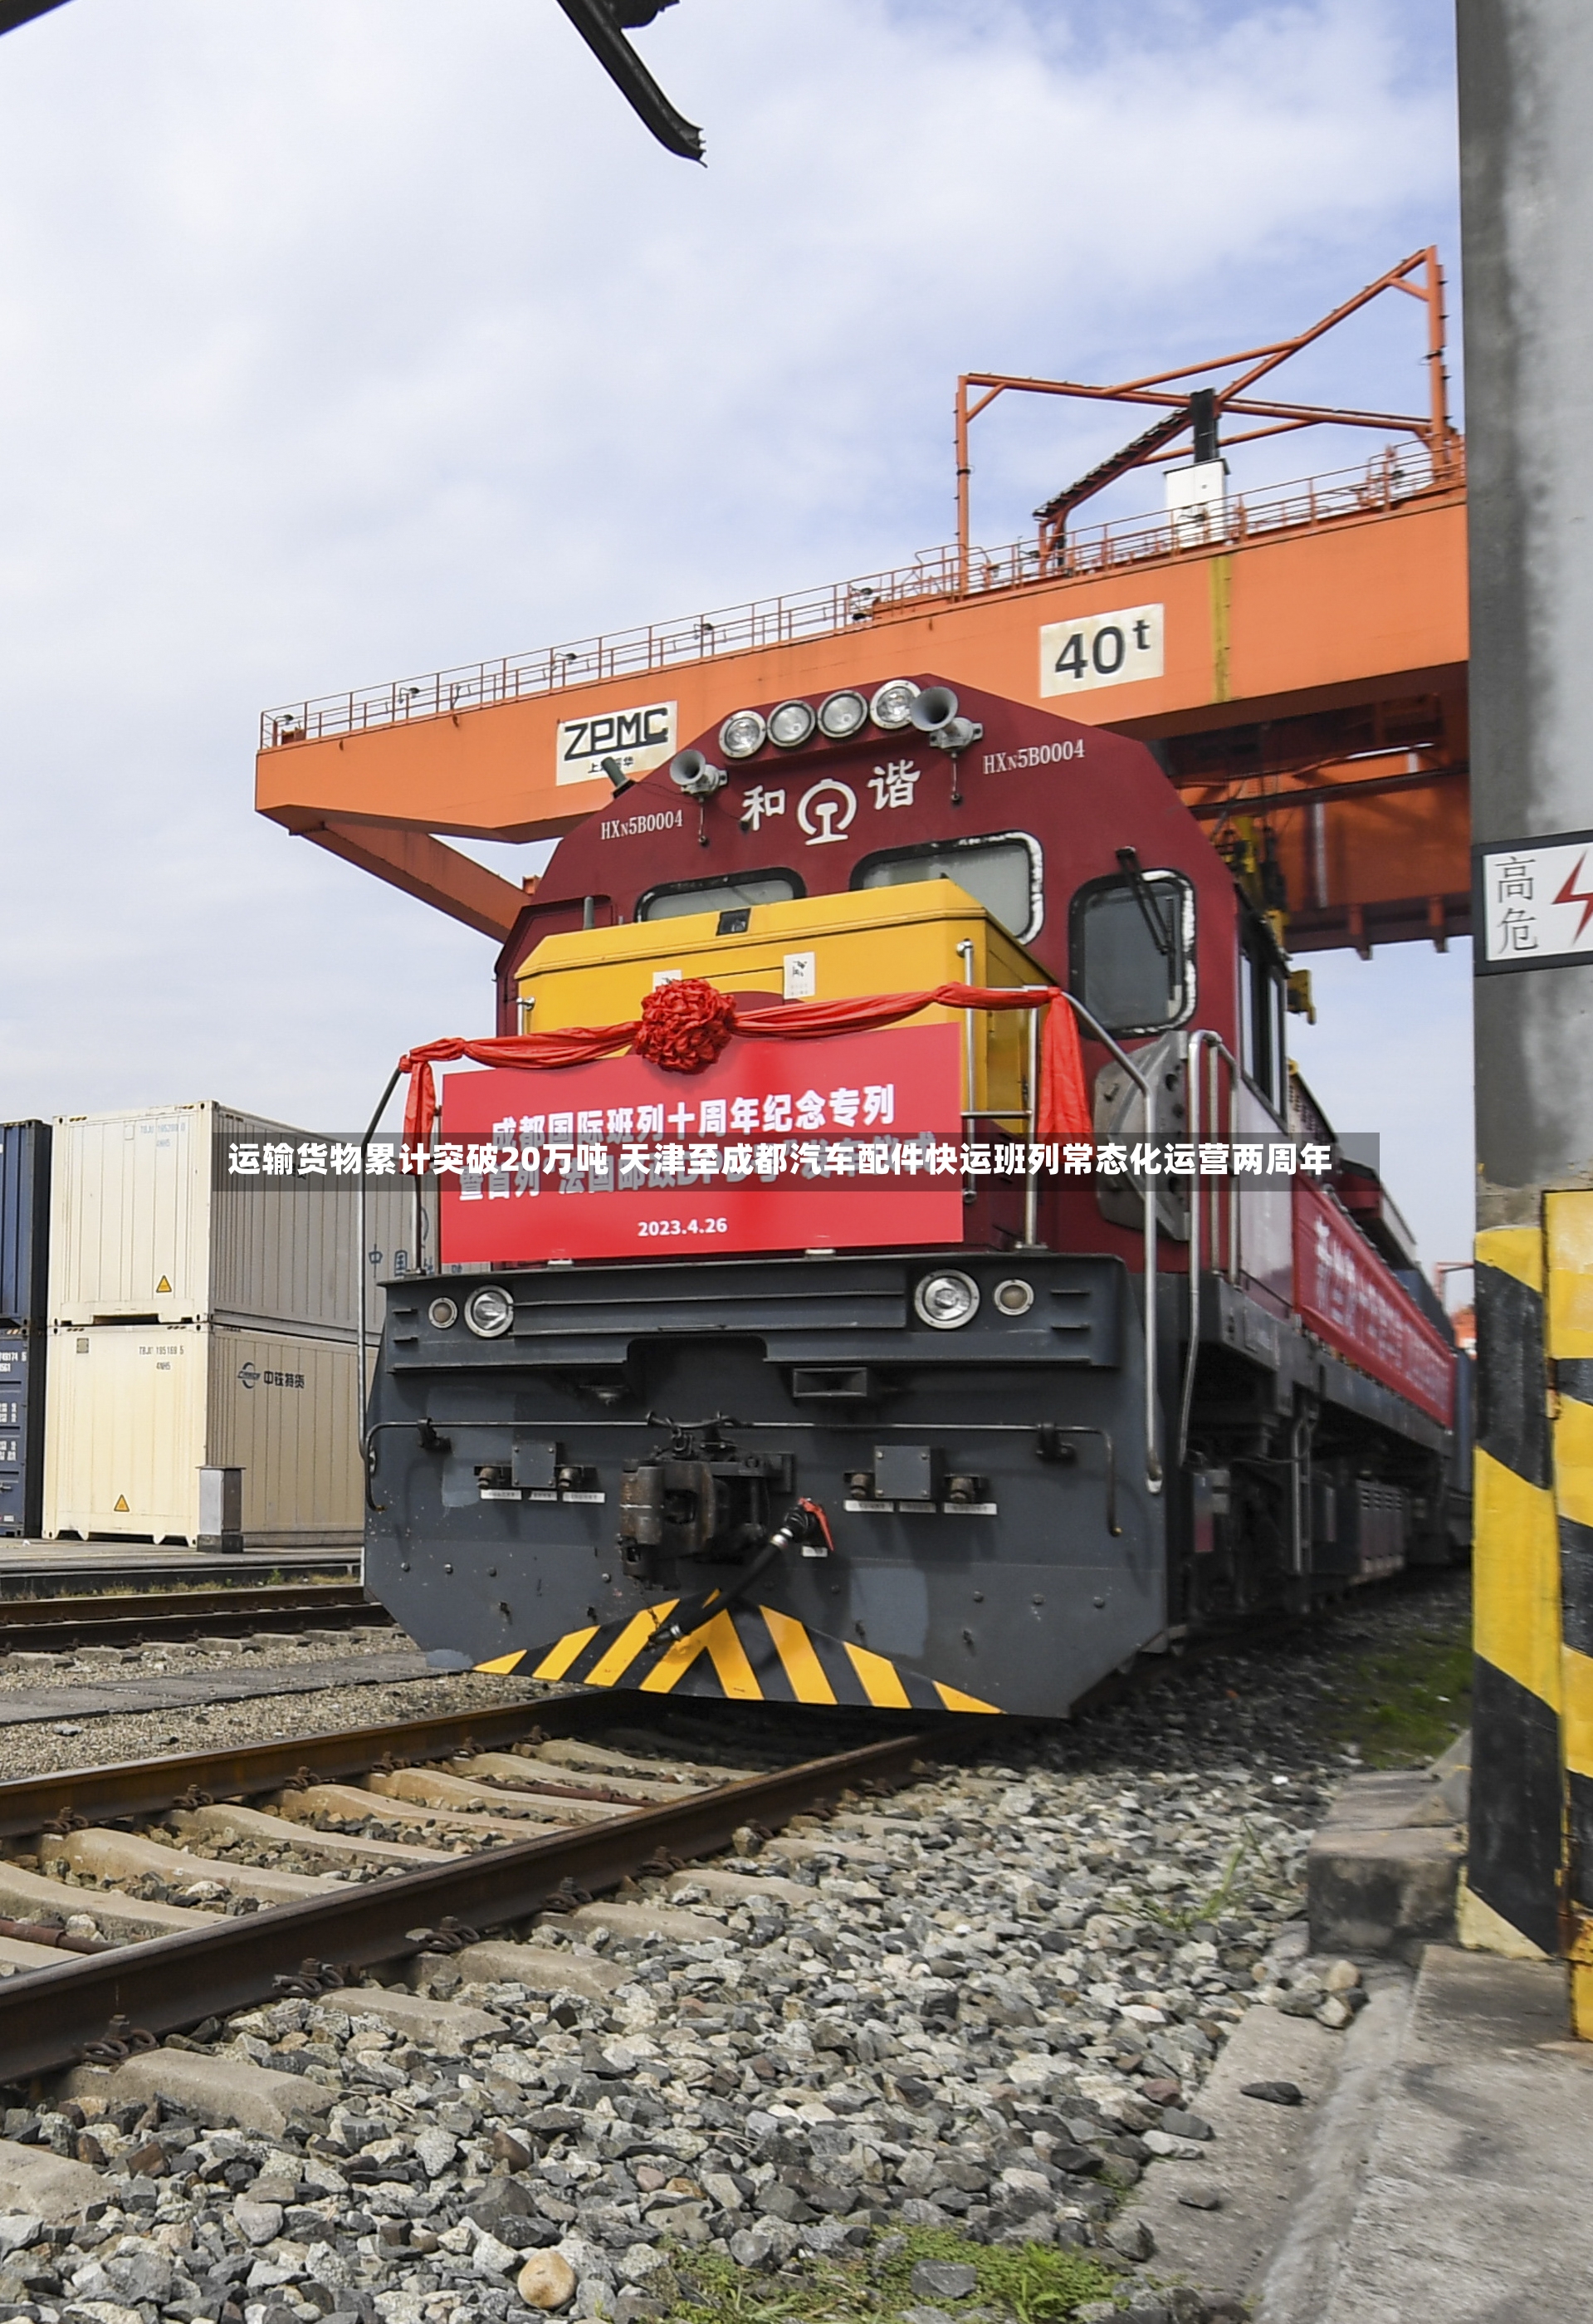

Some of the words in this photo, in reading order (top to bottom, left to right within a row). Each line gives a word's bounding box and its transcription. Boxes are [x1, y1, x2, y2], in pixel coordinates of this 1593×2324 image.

[564, 707, 668, 761] ZPMC
[740, 785, 786, 831] 和
[867, 759, 921, 810] 谐
[1494, 856, 1538, 955] 高危
[638, 1216, 728, 1237] 2023.4.26
